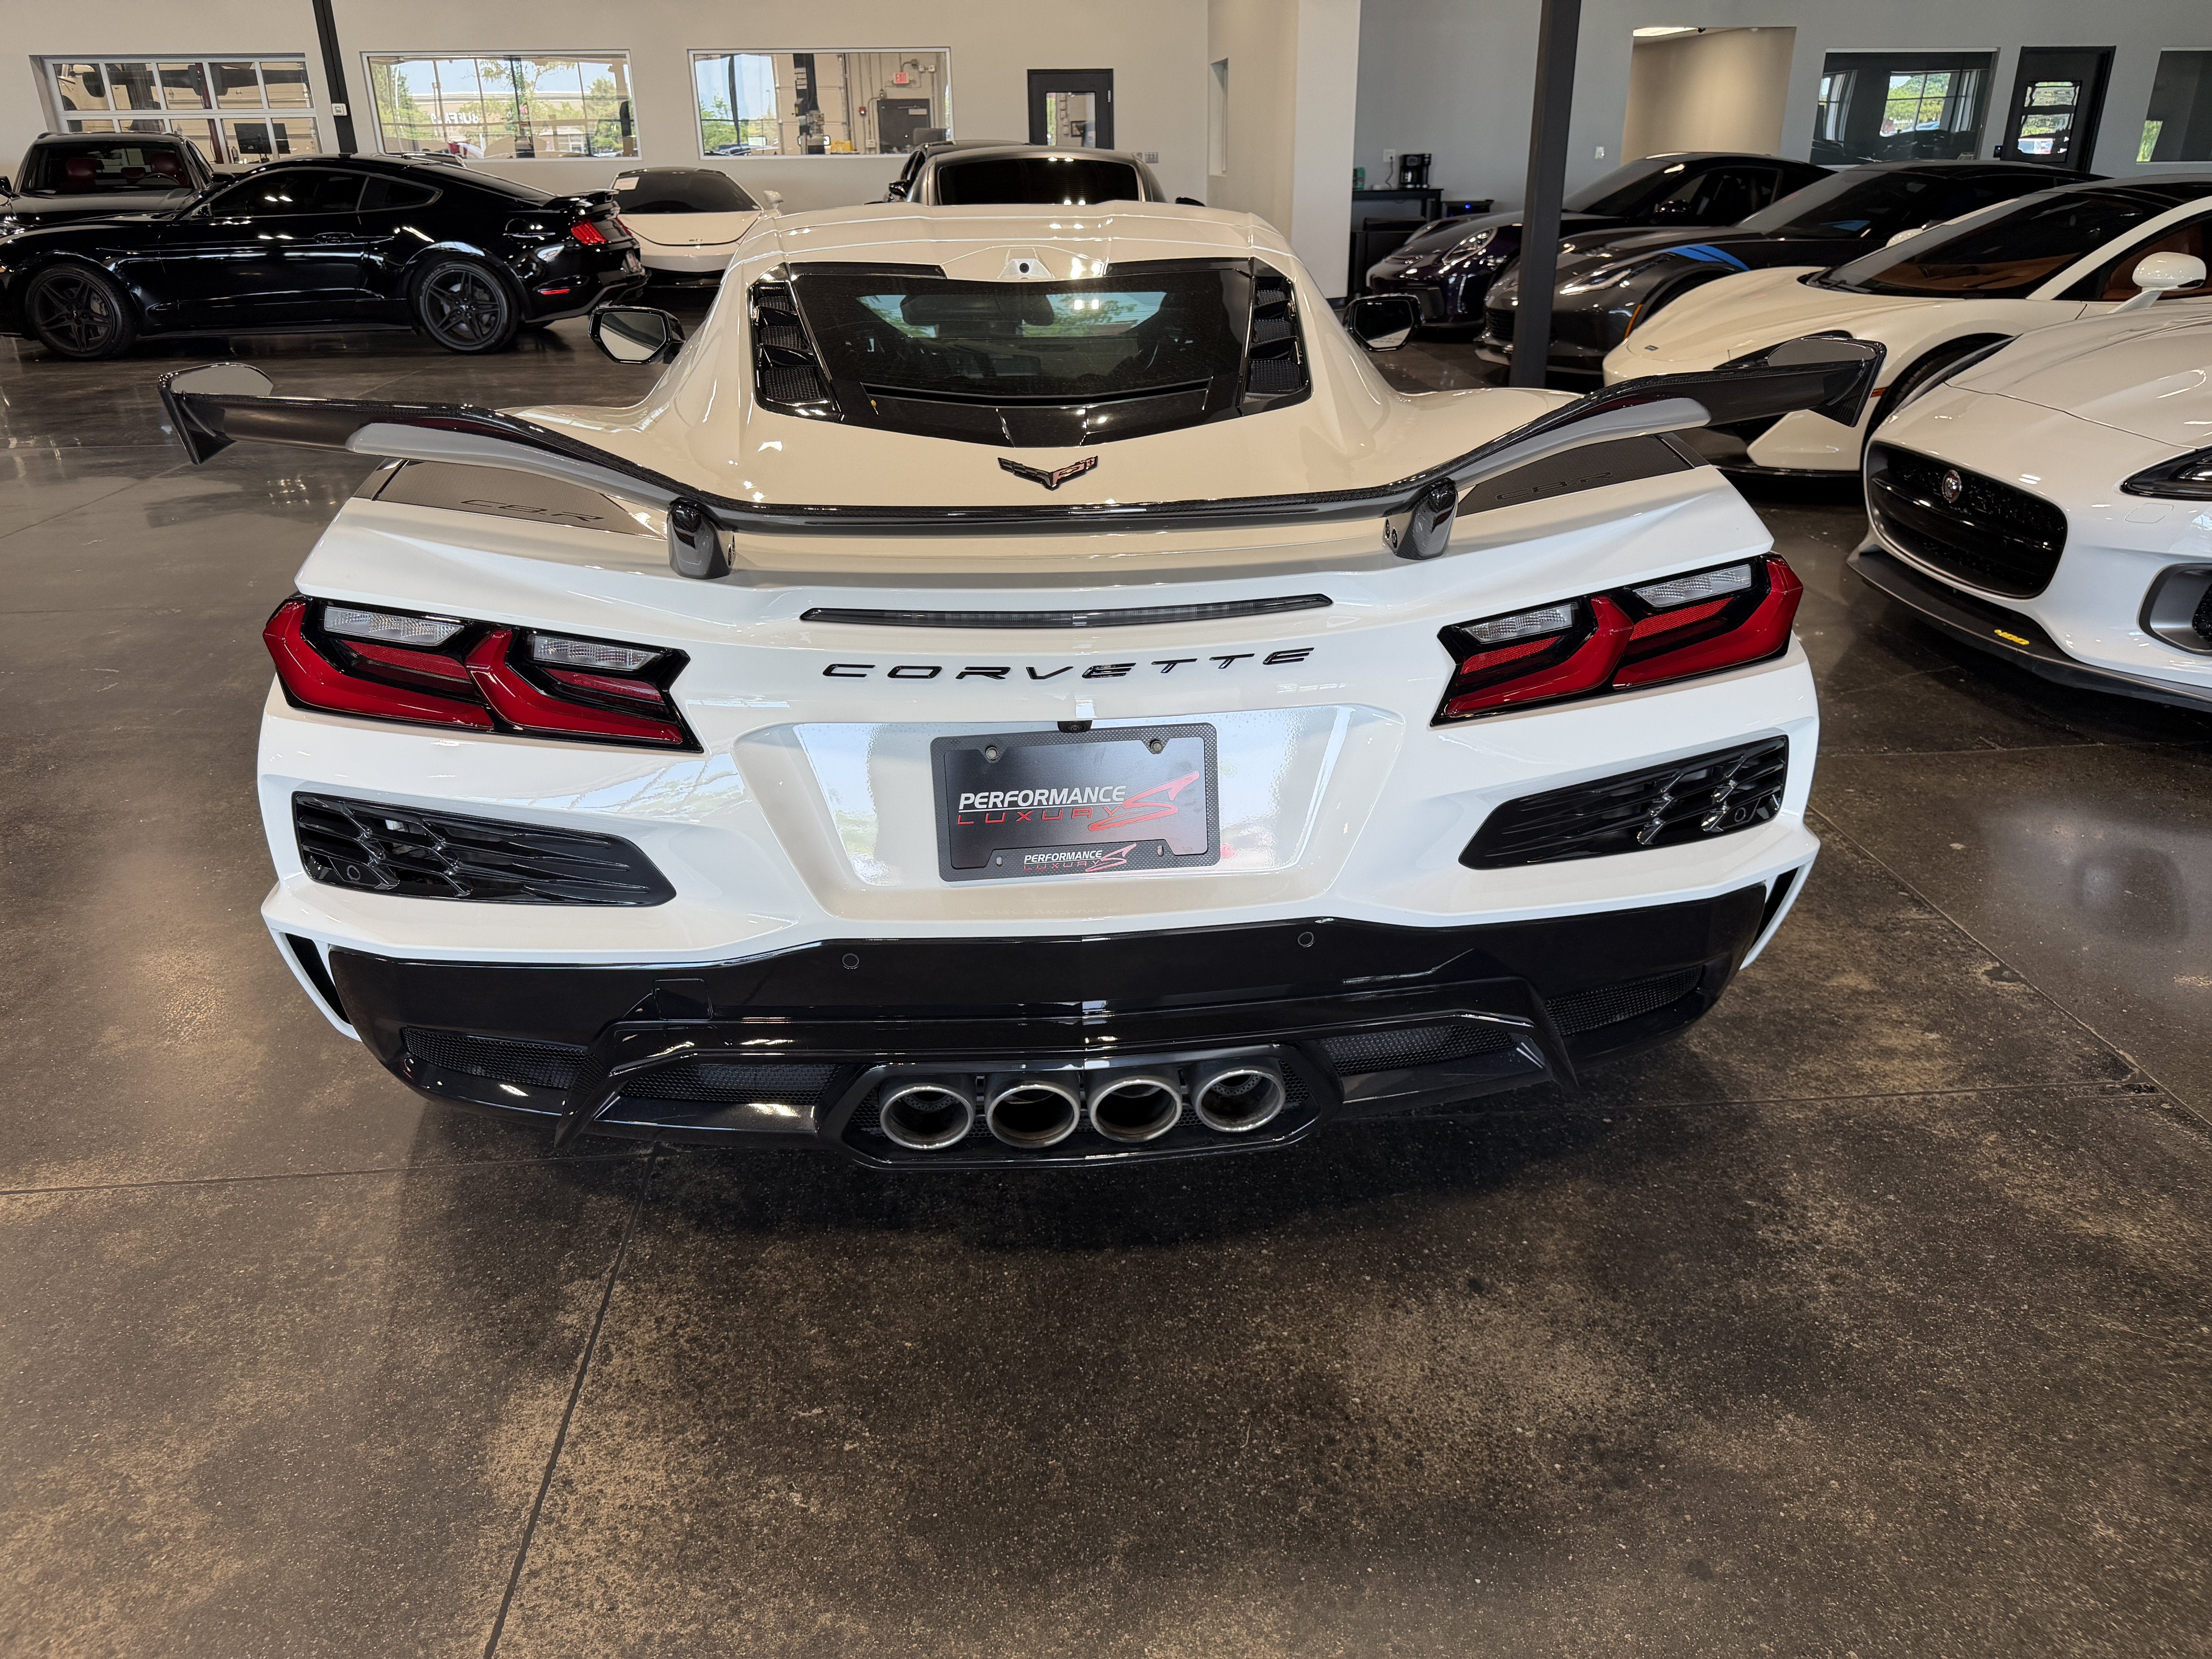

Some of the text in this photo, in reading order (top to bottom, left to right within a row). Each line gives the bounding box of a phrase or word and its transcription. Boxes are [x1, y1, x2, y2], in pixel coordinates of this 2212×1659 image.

[823, 647, 1314, 680] CORVETTE
[958, 785, 1126, 810] PERFORMANCE
[957, 805, 1123, 825] LUXURY
[1024, 850, 1103, 864] PERFORMANCE
[1024, 860, 1100, 871] LUXURY
